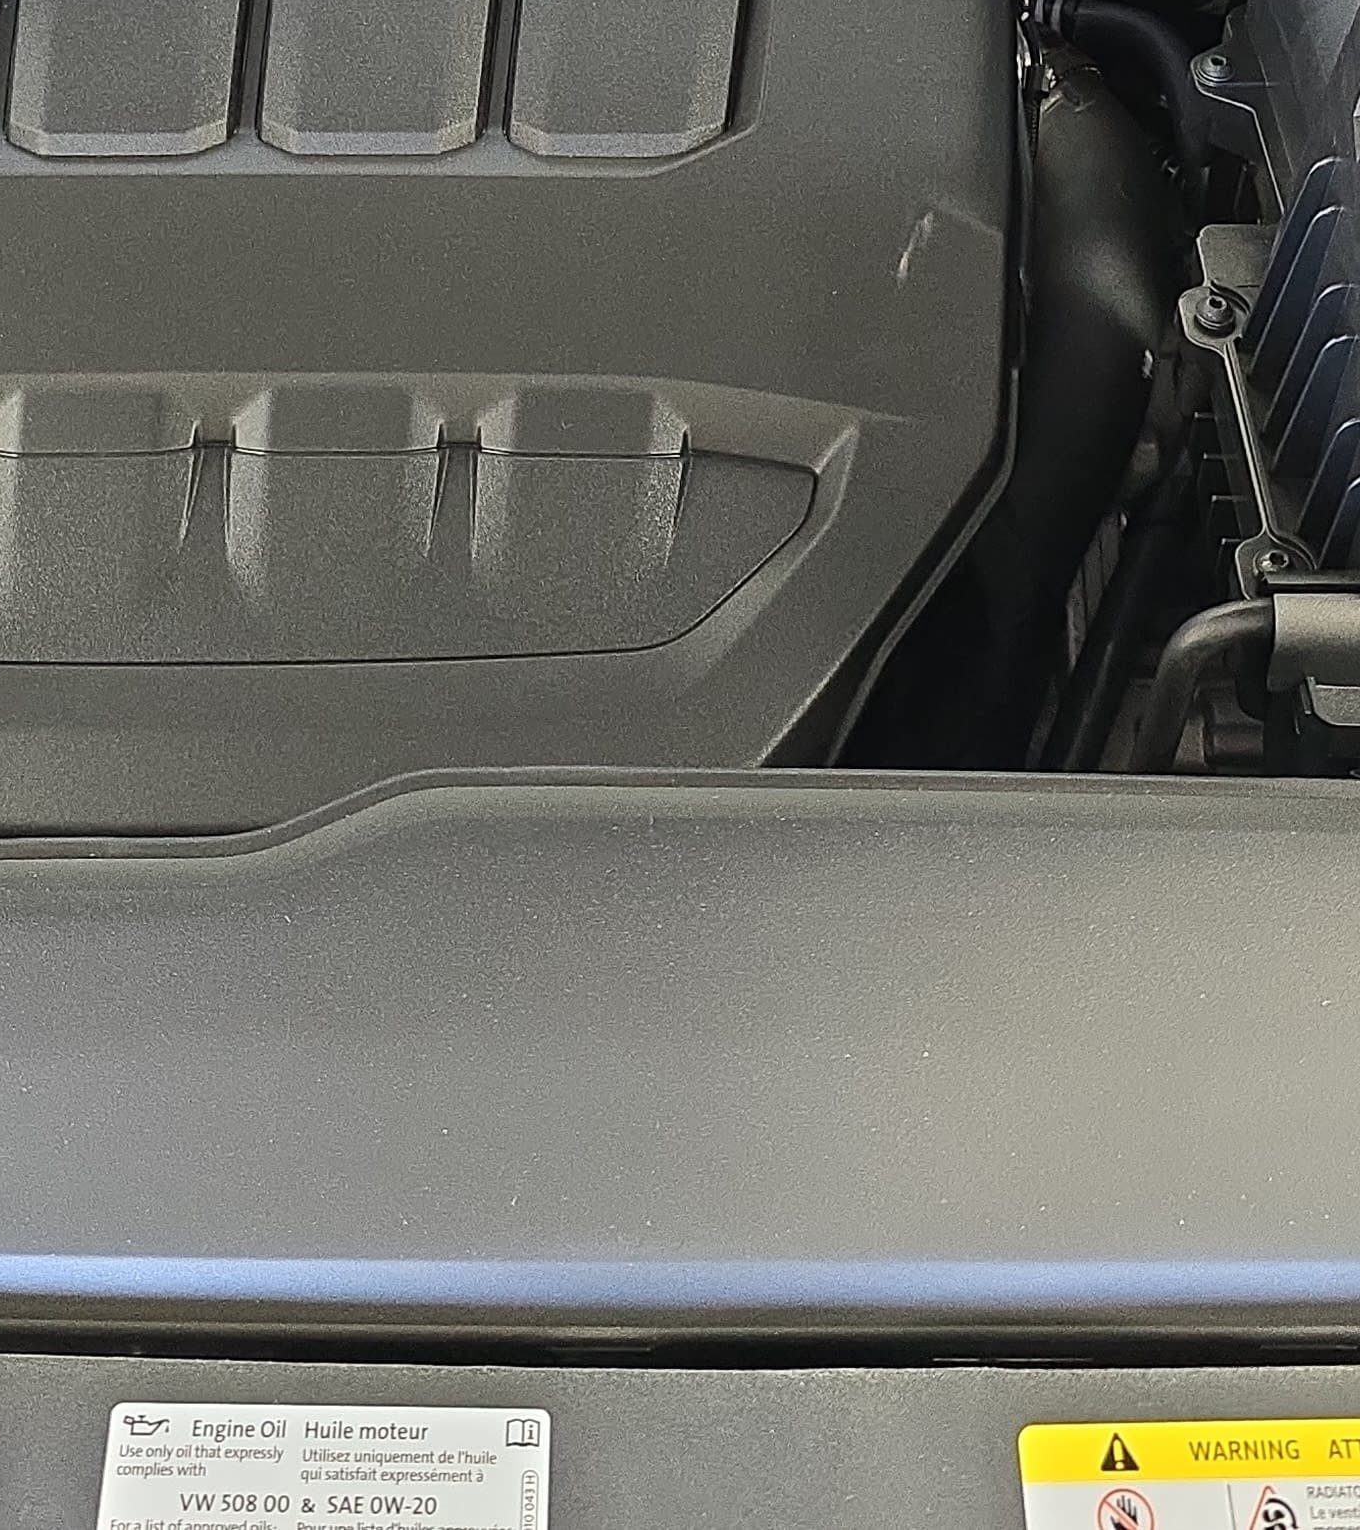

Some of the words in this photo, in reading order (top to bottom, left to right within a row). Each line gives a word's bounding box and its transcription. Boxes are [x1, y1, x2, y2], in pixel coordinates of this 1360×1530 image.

[192, 1419, 255, 1443] Engine
[260, 1420, 287, 1438] Oil
[305, 1421, 354, 1440] Huile
[359, 1423, 429, 1441] moteur
[119, 1445, 143, 1458] Use
[146, 1445, 173, 1462] only
[176, 1445, 191, 1458] oil
[195, 1445, 221, 1458] that
[224, 1446, 285, 1464] expressly
[302, 1449, 350, 1463] Utilisez
[354, 1451, 435, 1468] uniquement
[438, 1450, 454, 1464] de
[457, 1450, 498, 1465] l'huile
[1189, 1440, 1300, 1461] WARNING
[116, 1463, 174, 1479] complies
[177, 1463, 207, 1477] with
[300, 1468, 322, 1484] qui
[324, 1467, 377, 1482] satisfait
[380, 1469, 473, 1485] expressément
[476, 1470, 485, 1483] à
[180, 1493, 216, 1512] VW
[221, 1494, 257, 1513] 508
[264, 1495, 290, 1513] 00
[301, 1498, 316, 1514] &
[327, 1496, 365, 1515] SAE
[370, 1496, 438, 1516] 0W-20
[1309, 1506, 1326, 1520] Le
